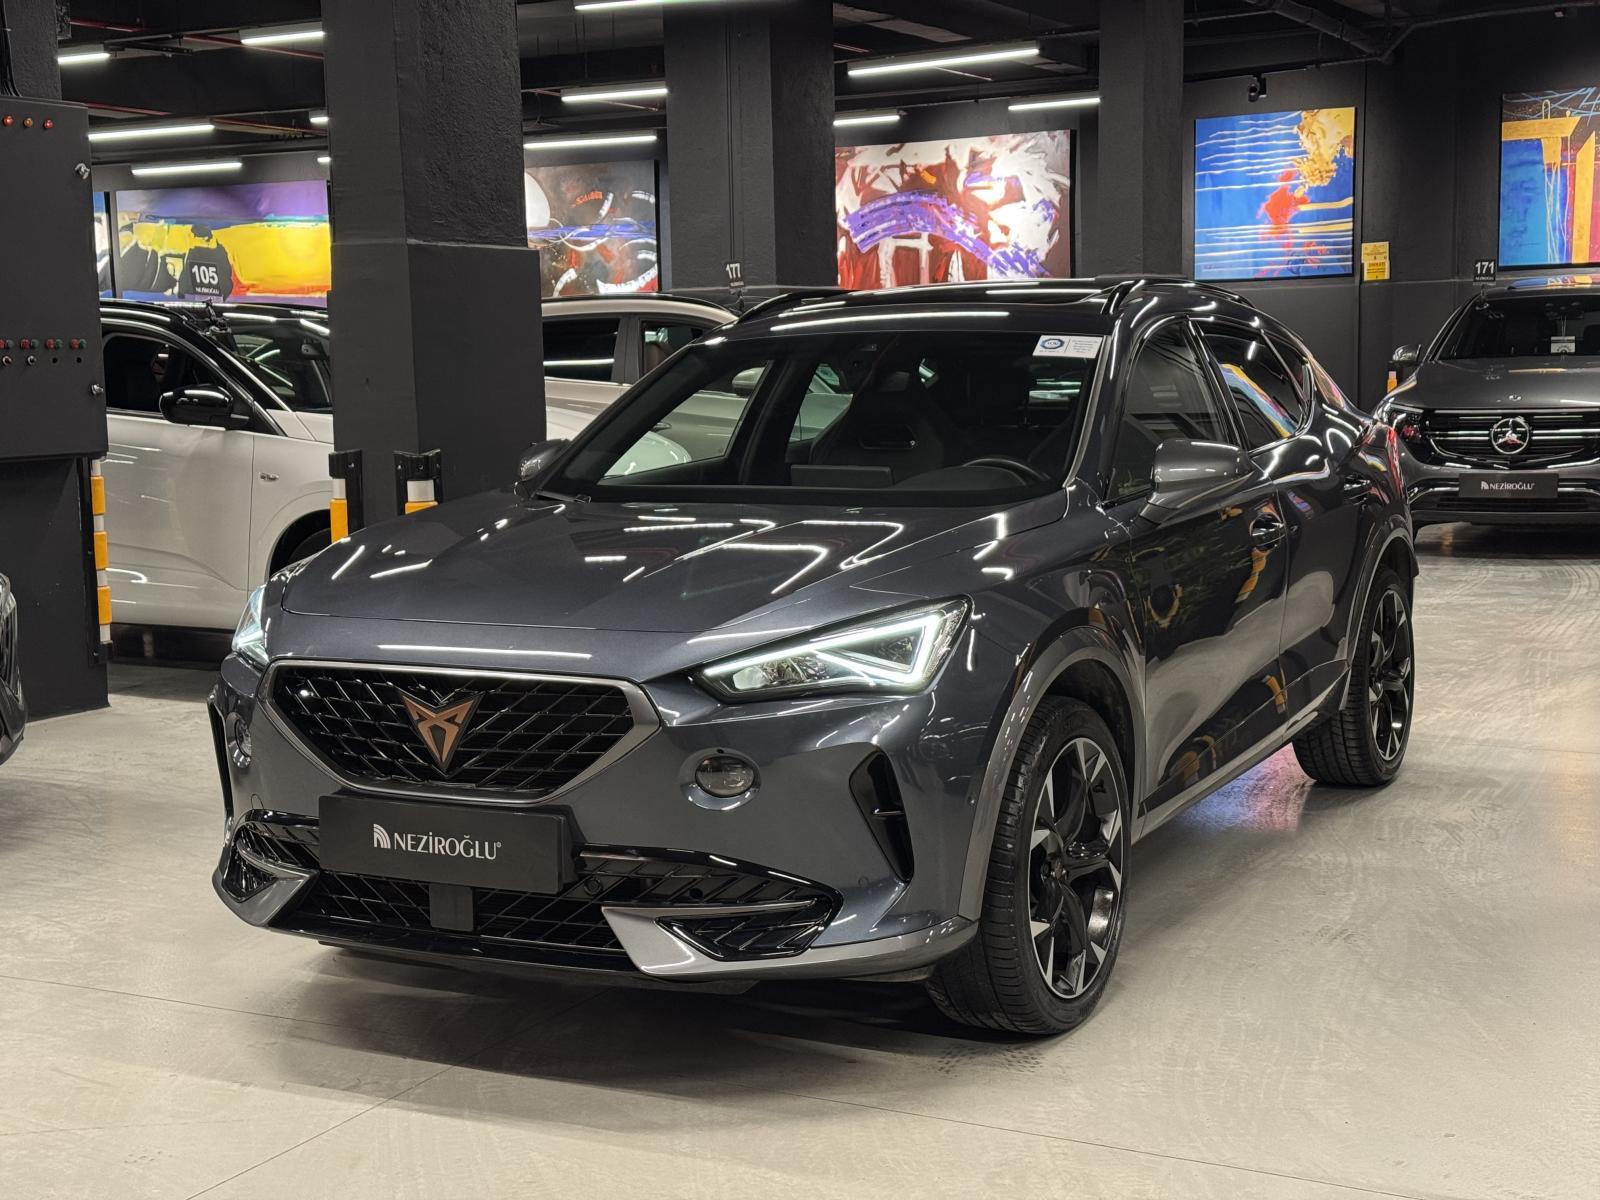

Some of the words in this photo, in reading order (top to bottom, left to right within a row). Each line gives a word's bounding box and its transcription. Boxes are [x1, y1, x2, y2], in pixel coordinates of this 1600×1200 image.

[191, 264, 219, 285] 105
[725, 263, 741, 279] 177
[1475, 261, 1495, 274] 171
[1489, 482, 1533, 490] NEZİROĞLU
[394, 832, 498, 860] NEZİROĞLU
